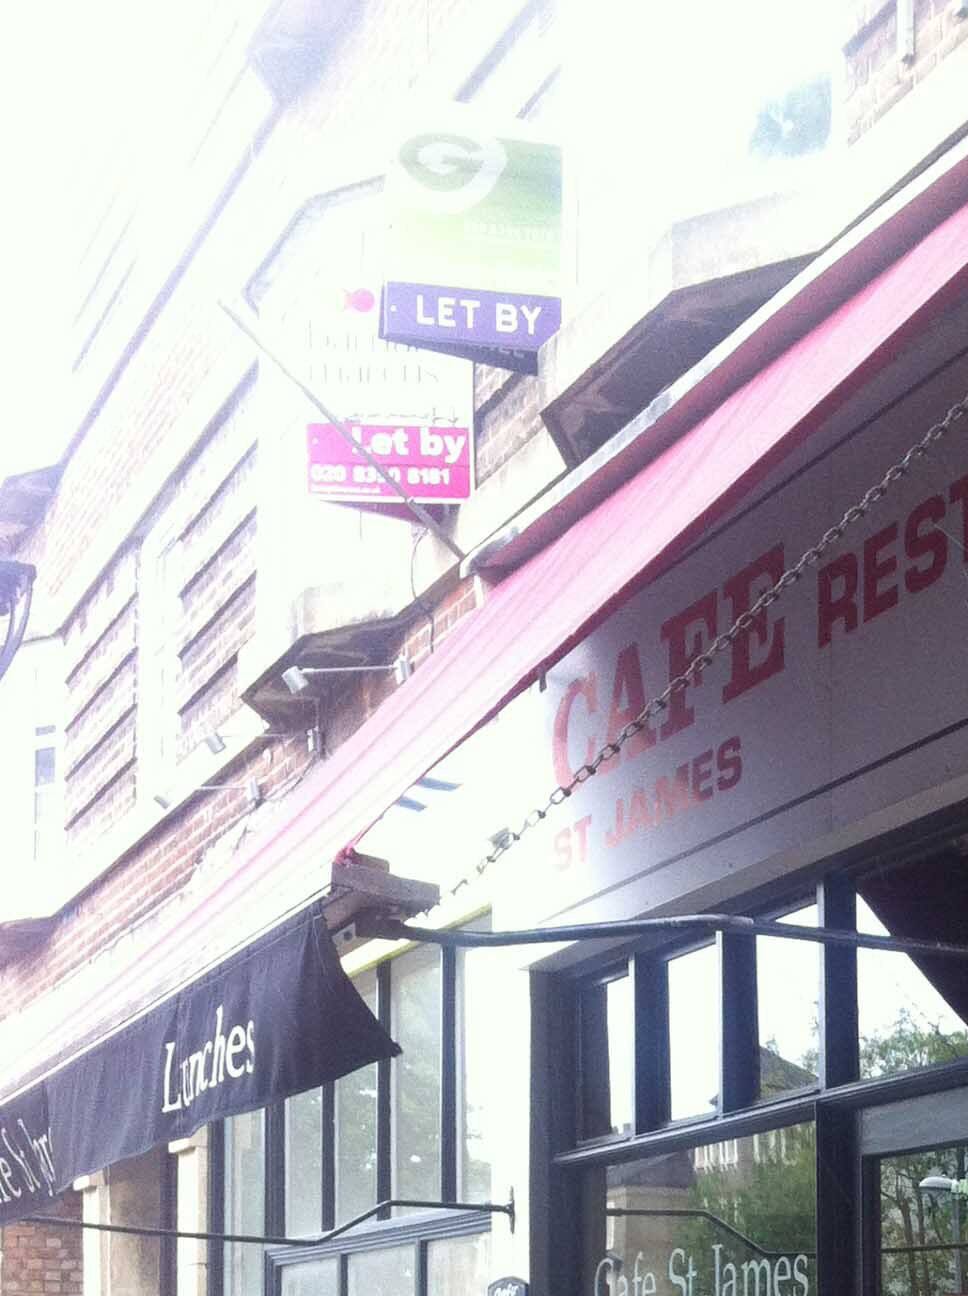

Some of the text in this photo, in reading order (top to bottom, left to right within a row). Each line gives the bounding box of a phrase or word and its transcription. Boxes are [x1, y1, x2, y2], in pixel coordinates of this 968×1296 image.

[416, 294, 543, 336] LET BY
[351, 426, 466, 465] Let by
[552, 541, 785, 793] CAFE
[552, 735, 744, 873] ST JAMES
